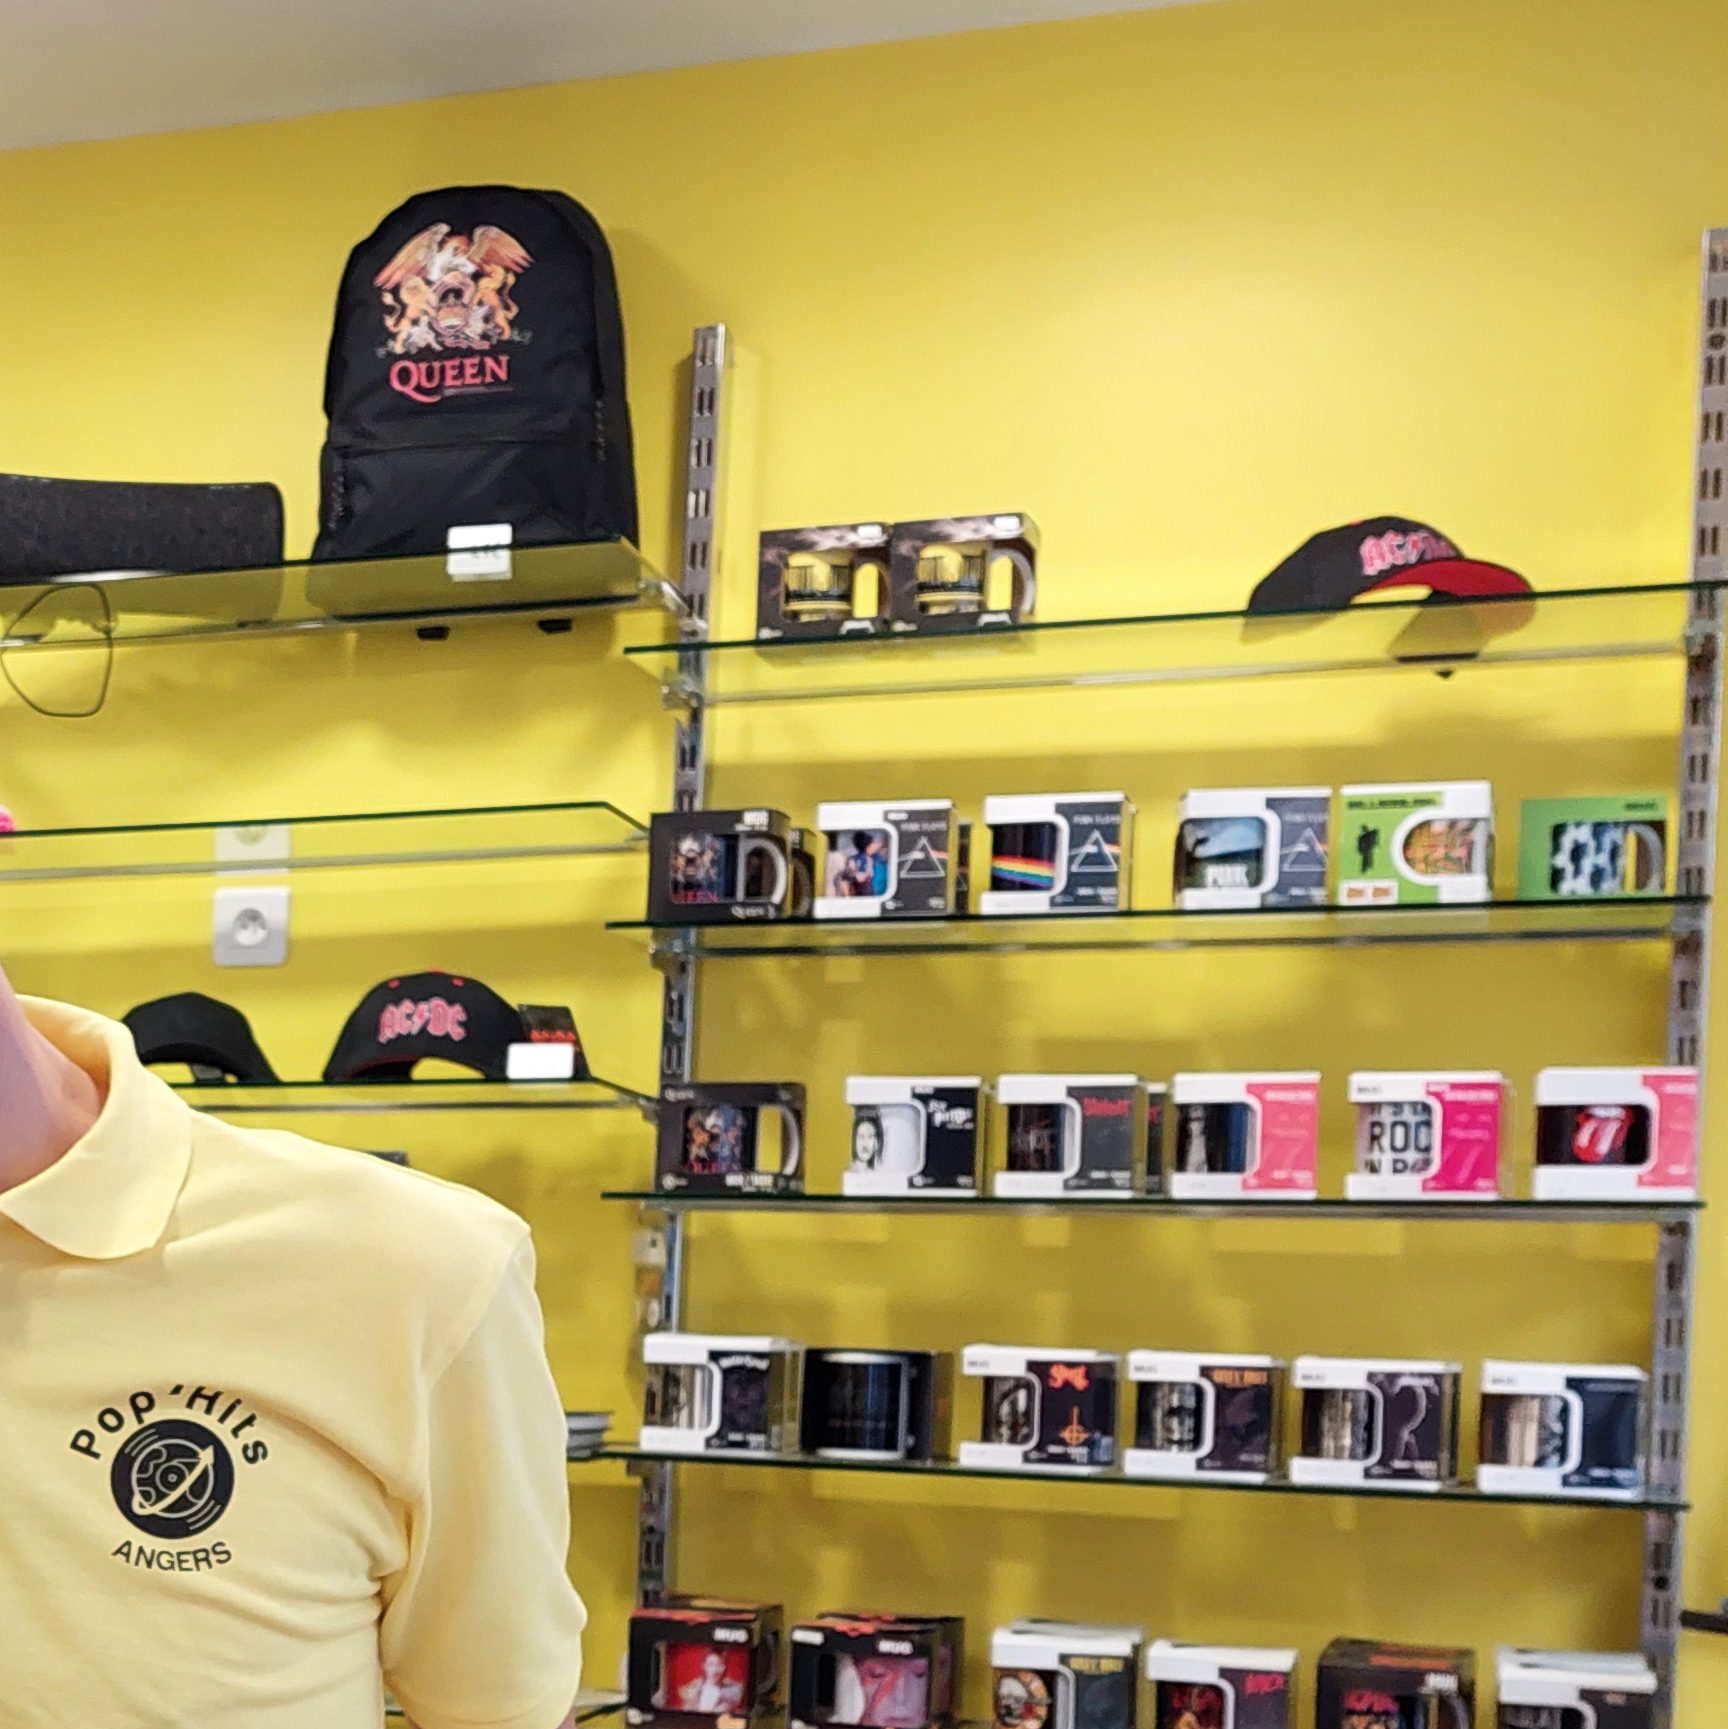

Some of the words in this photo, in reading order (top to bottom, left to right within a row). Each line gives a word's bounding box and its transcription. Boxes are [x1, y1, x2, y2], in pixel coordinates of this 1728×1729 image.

[389, 354, 510, 404] QUEEN
[378, 996, 466, 1044] AC/DC
[111, 1541, 232, 1571] ANGERS
